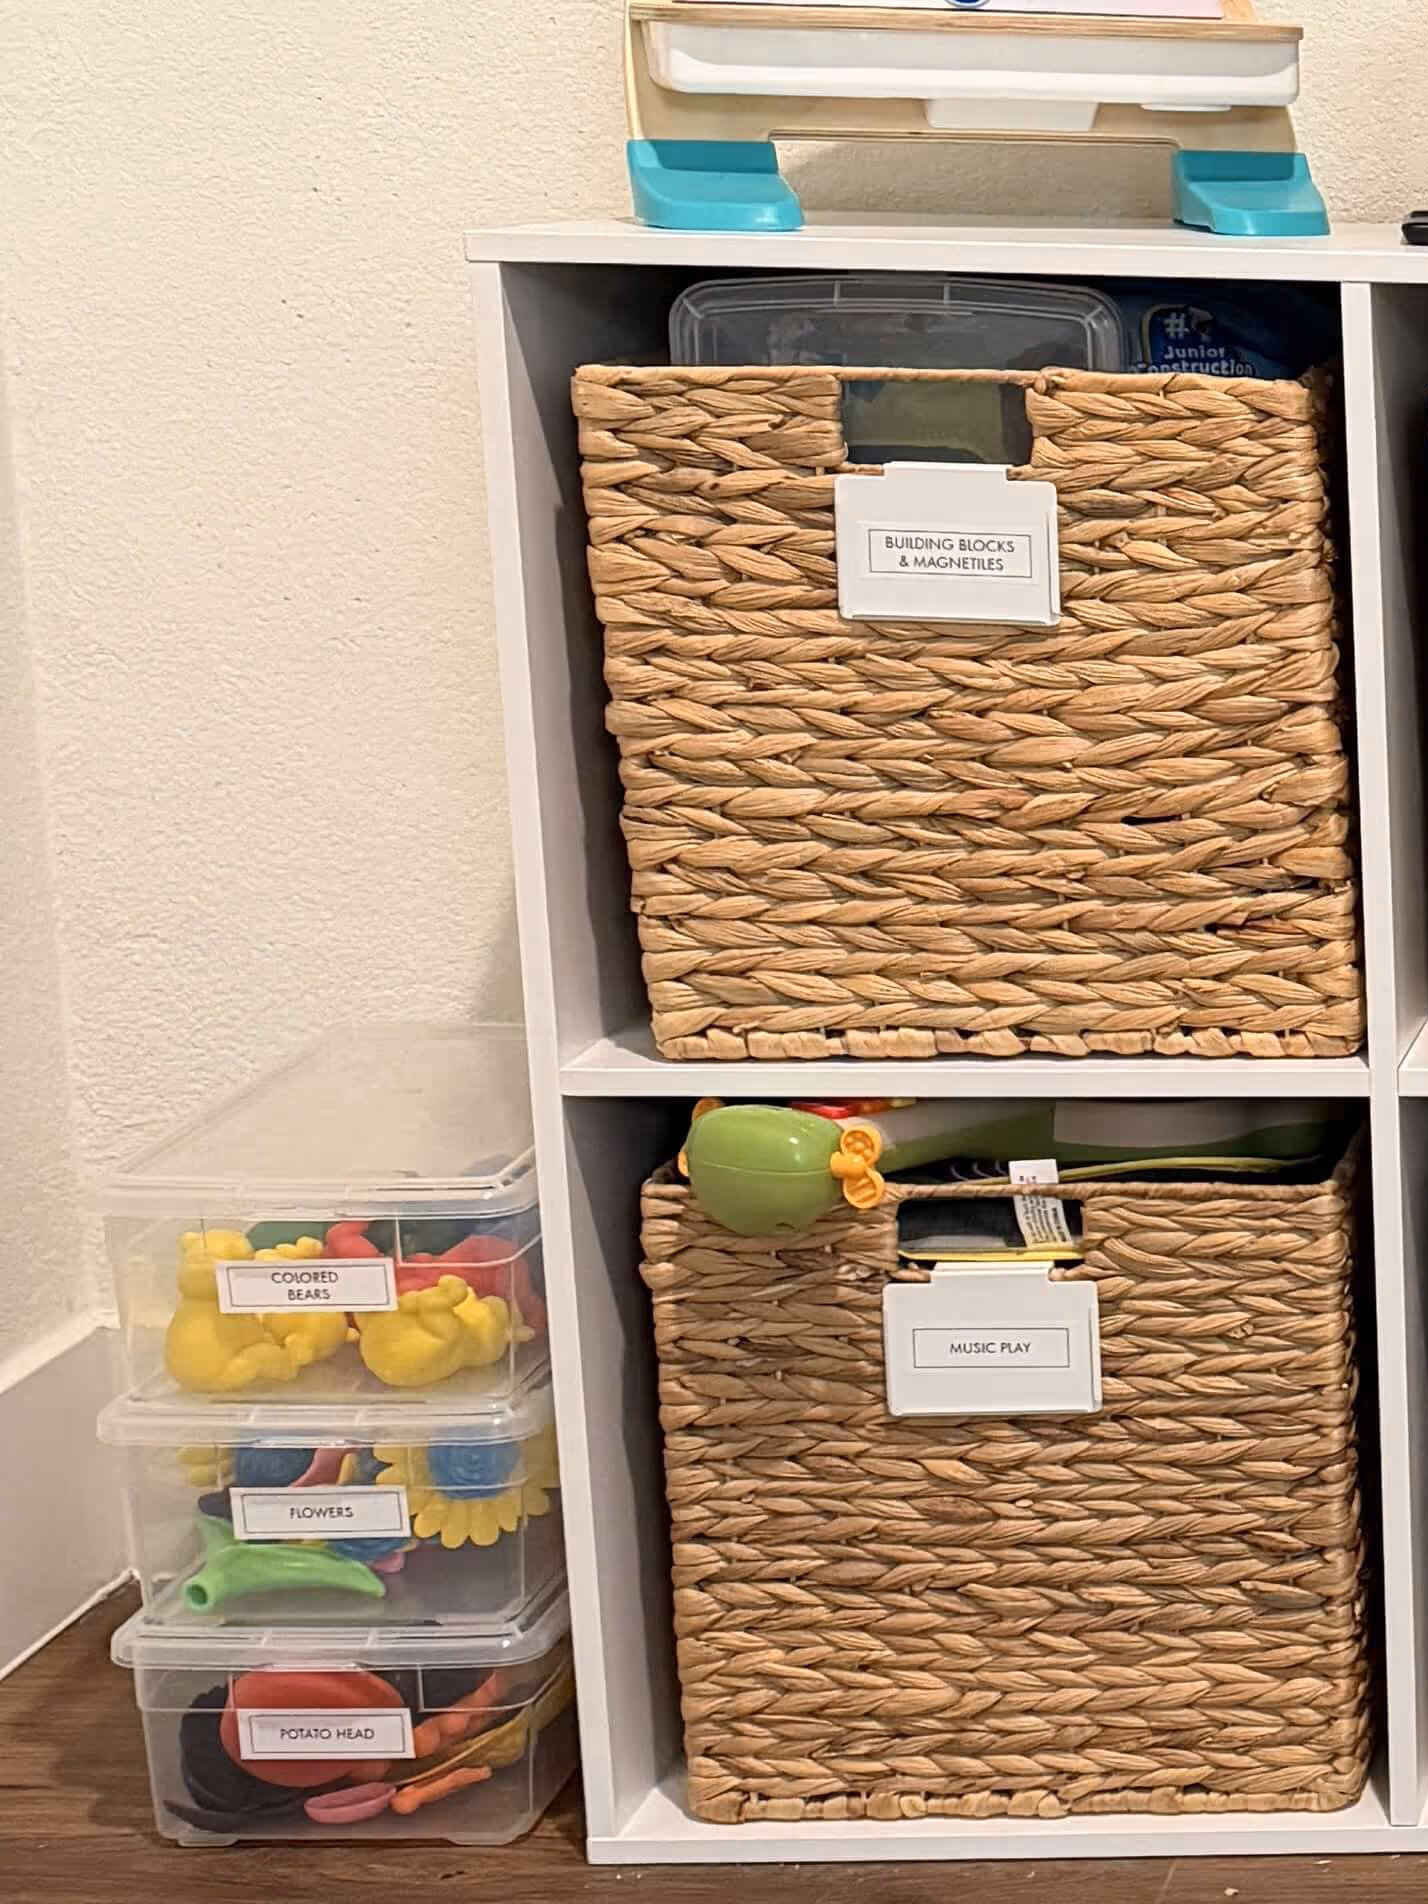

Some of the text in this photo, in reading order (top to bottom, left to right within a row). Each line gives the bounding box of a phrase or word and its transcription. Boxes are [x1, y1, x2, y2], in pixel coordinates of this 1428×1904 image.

[1164, 345, 1225, 359] Junior
[885, 536, 1015, 553] BUILDING BLOCKS
[899, 555, 1004, 571] & MAGNETILES
[271, 1271, 339, 1284] COLORED
[287, 1289, 331, 1301] BEARS
[949, 1341, 1032, 1355] MUSIC PLAY
[289, 1506, 355, 1520] FLOWERS
[280, 1727, 375, 1740] POTATO HEAD
